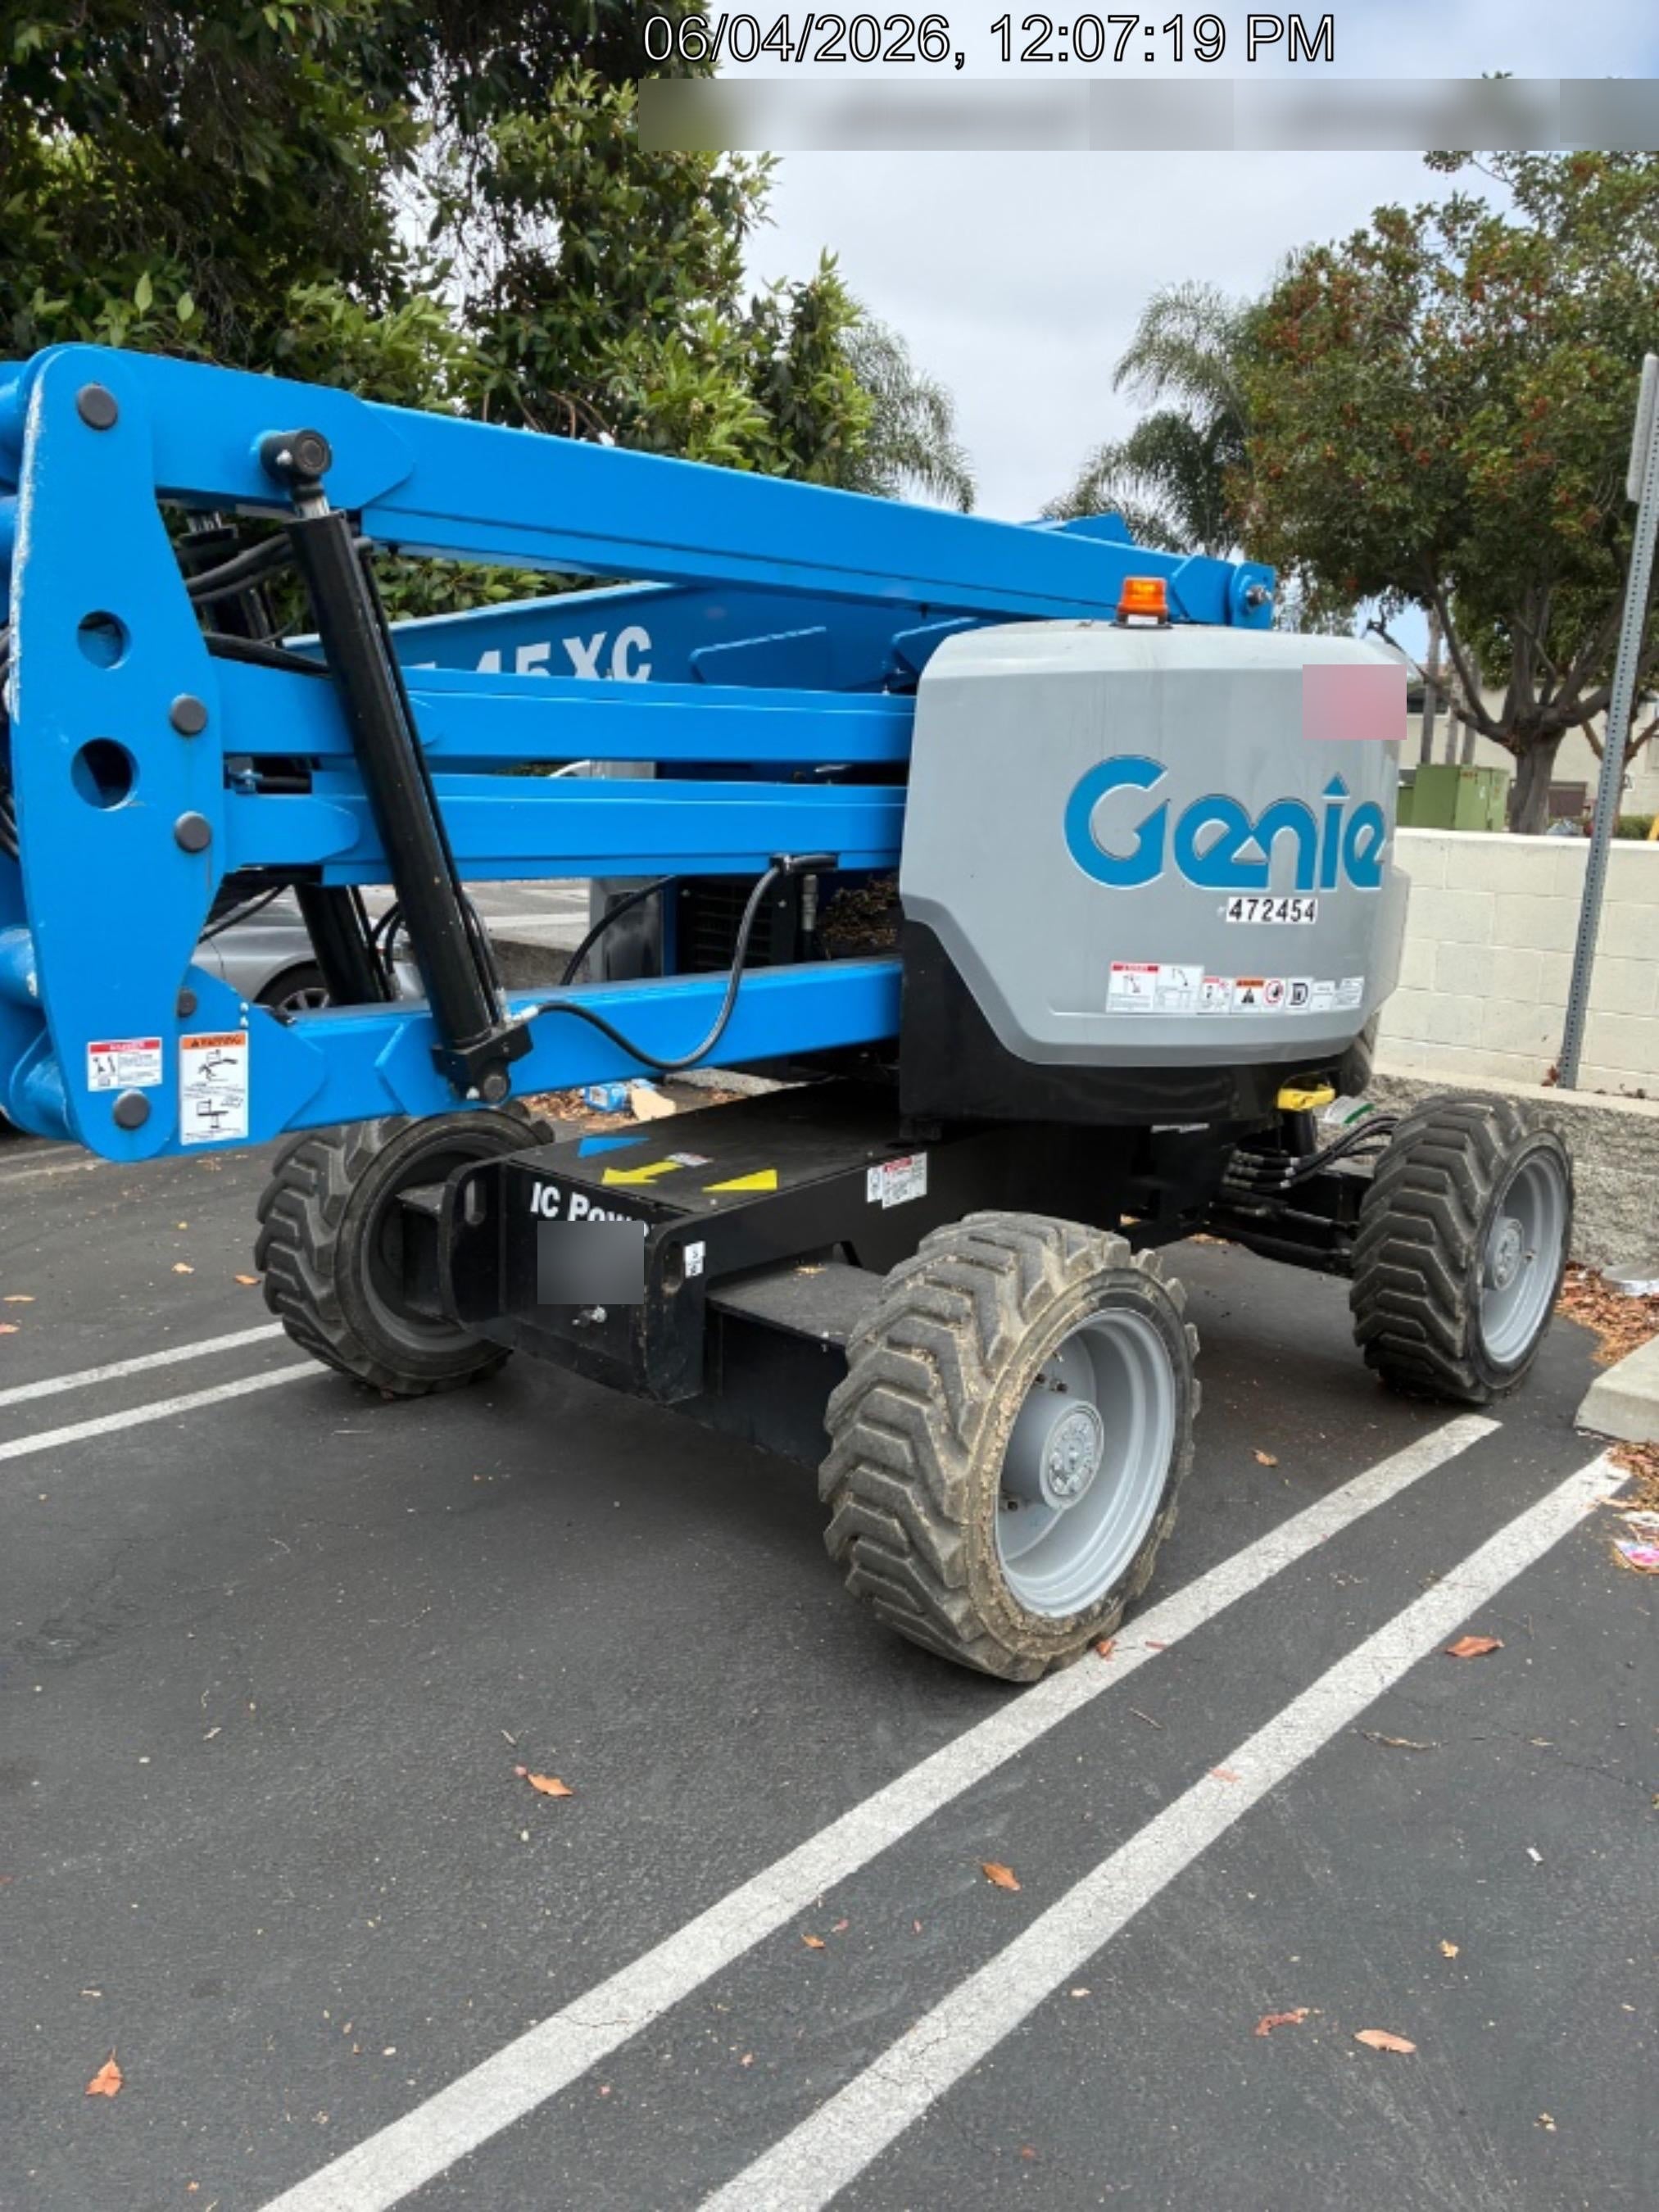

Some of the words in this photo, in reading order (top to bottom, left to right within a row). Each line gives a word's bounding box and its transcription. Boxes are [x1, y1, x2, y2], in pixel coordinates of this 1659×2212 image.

[1063, 754, 1386, 892] Genie
[1229, 898, 1316, 922] 472454
[530, 1181, 561, 1217] IC
